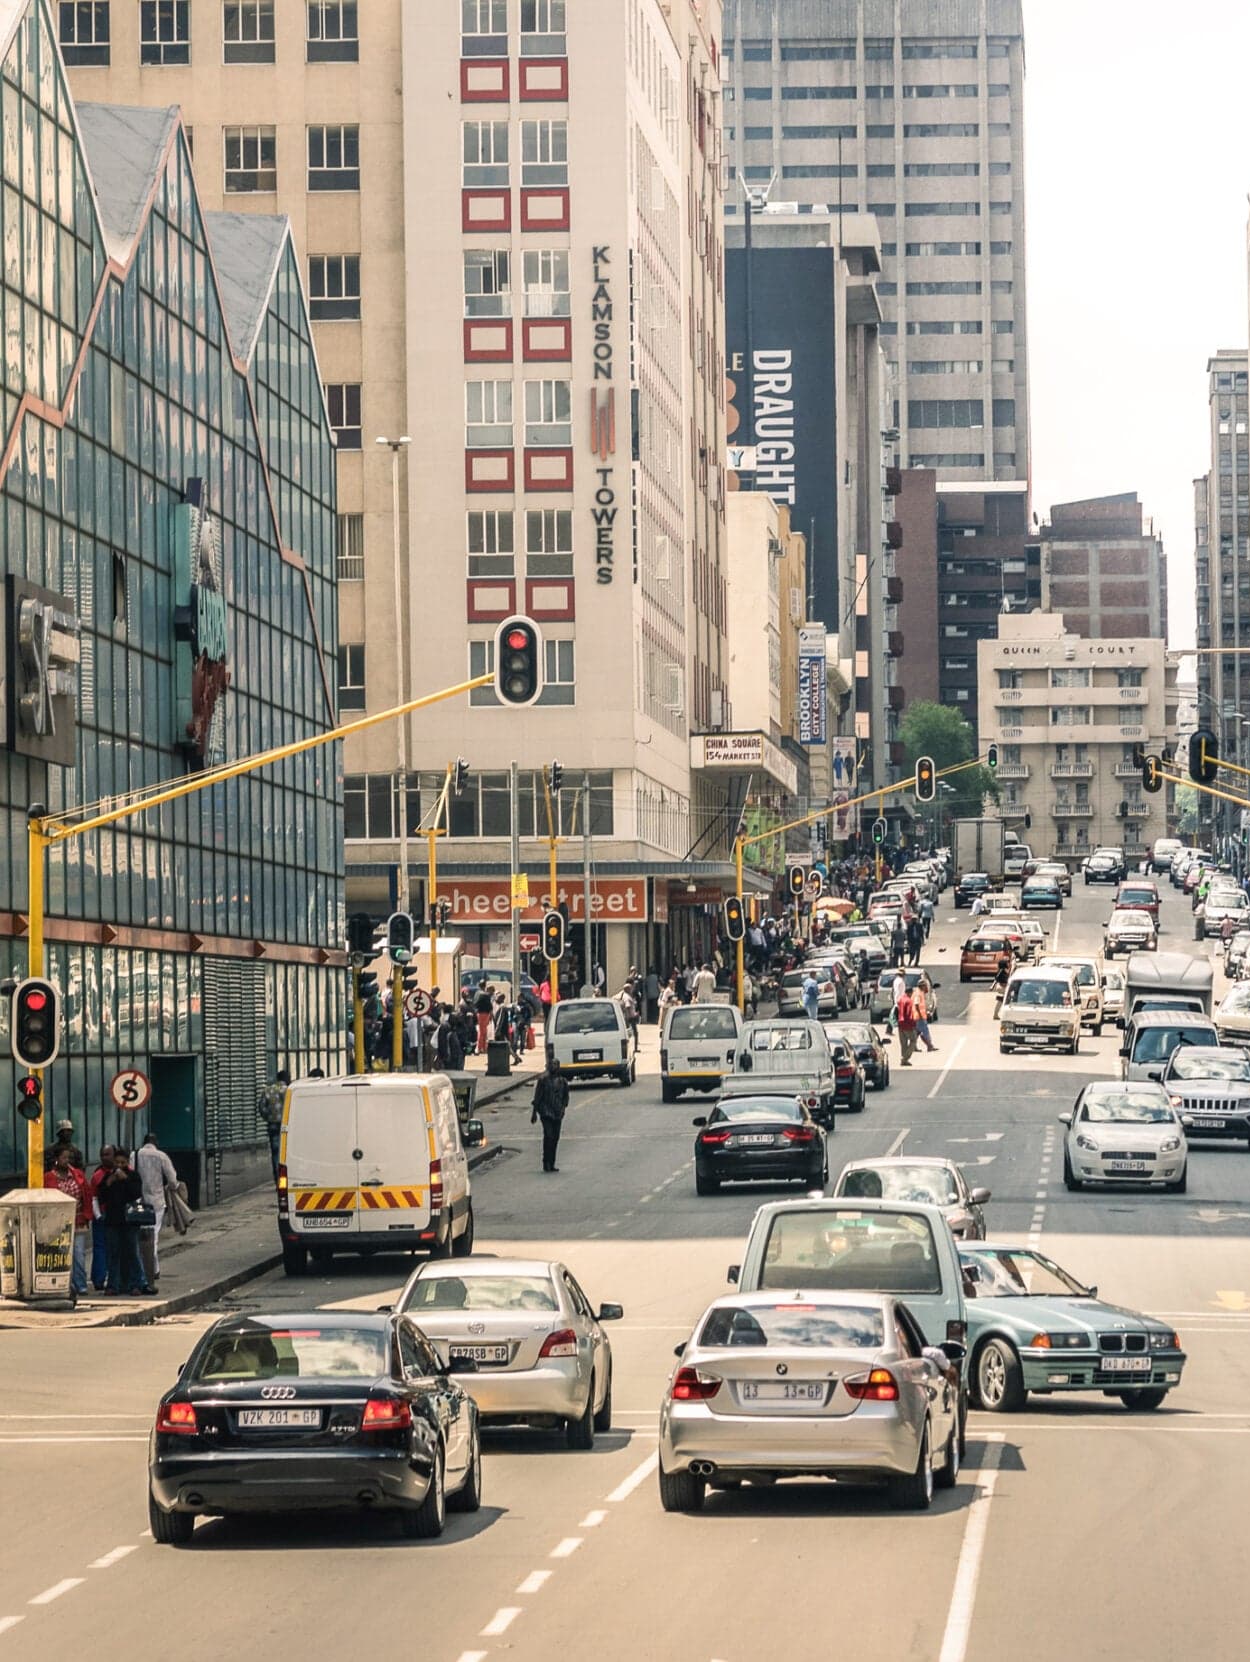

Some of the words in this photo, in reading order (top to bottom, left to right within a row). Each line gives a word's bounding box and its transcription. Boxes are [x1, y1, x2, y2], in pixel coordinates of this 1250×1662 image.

[591, 246, 613, 380] KLAMSON
[752, 349, 796, 505] DRAUGHT
[590, 467, 618, 585] TOWERS
[799, 659, 811, 741] BROOKLYN
[706, 739, 728, 749] CHINA
[732, 738, 761, 748] SQUARE
[268, 1410, 289, 1424] 201
[303, 1410, 317, 1423] GP
[807, 1384, 821, 1398] GP
